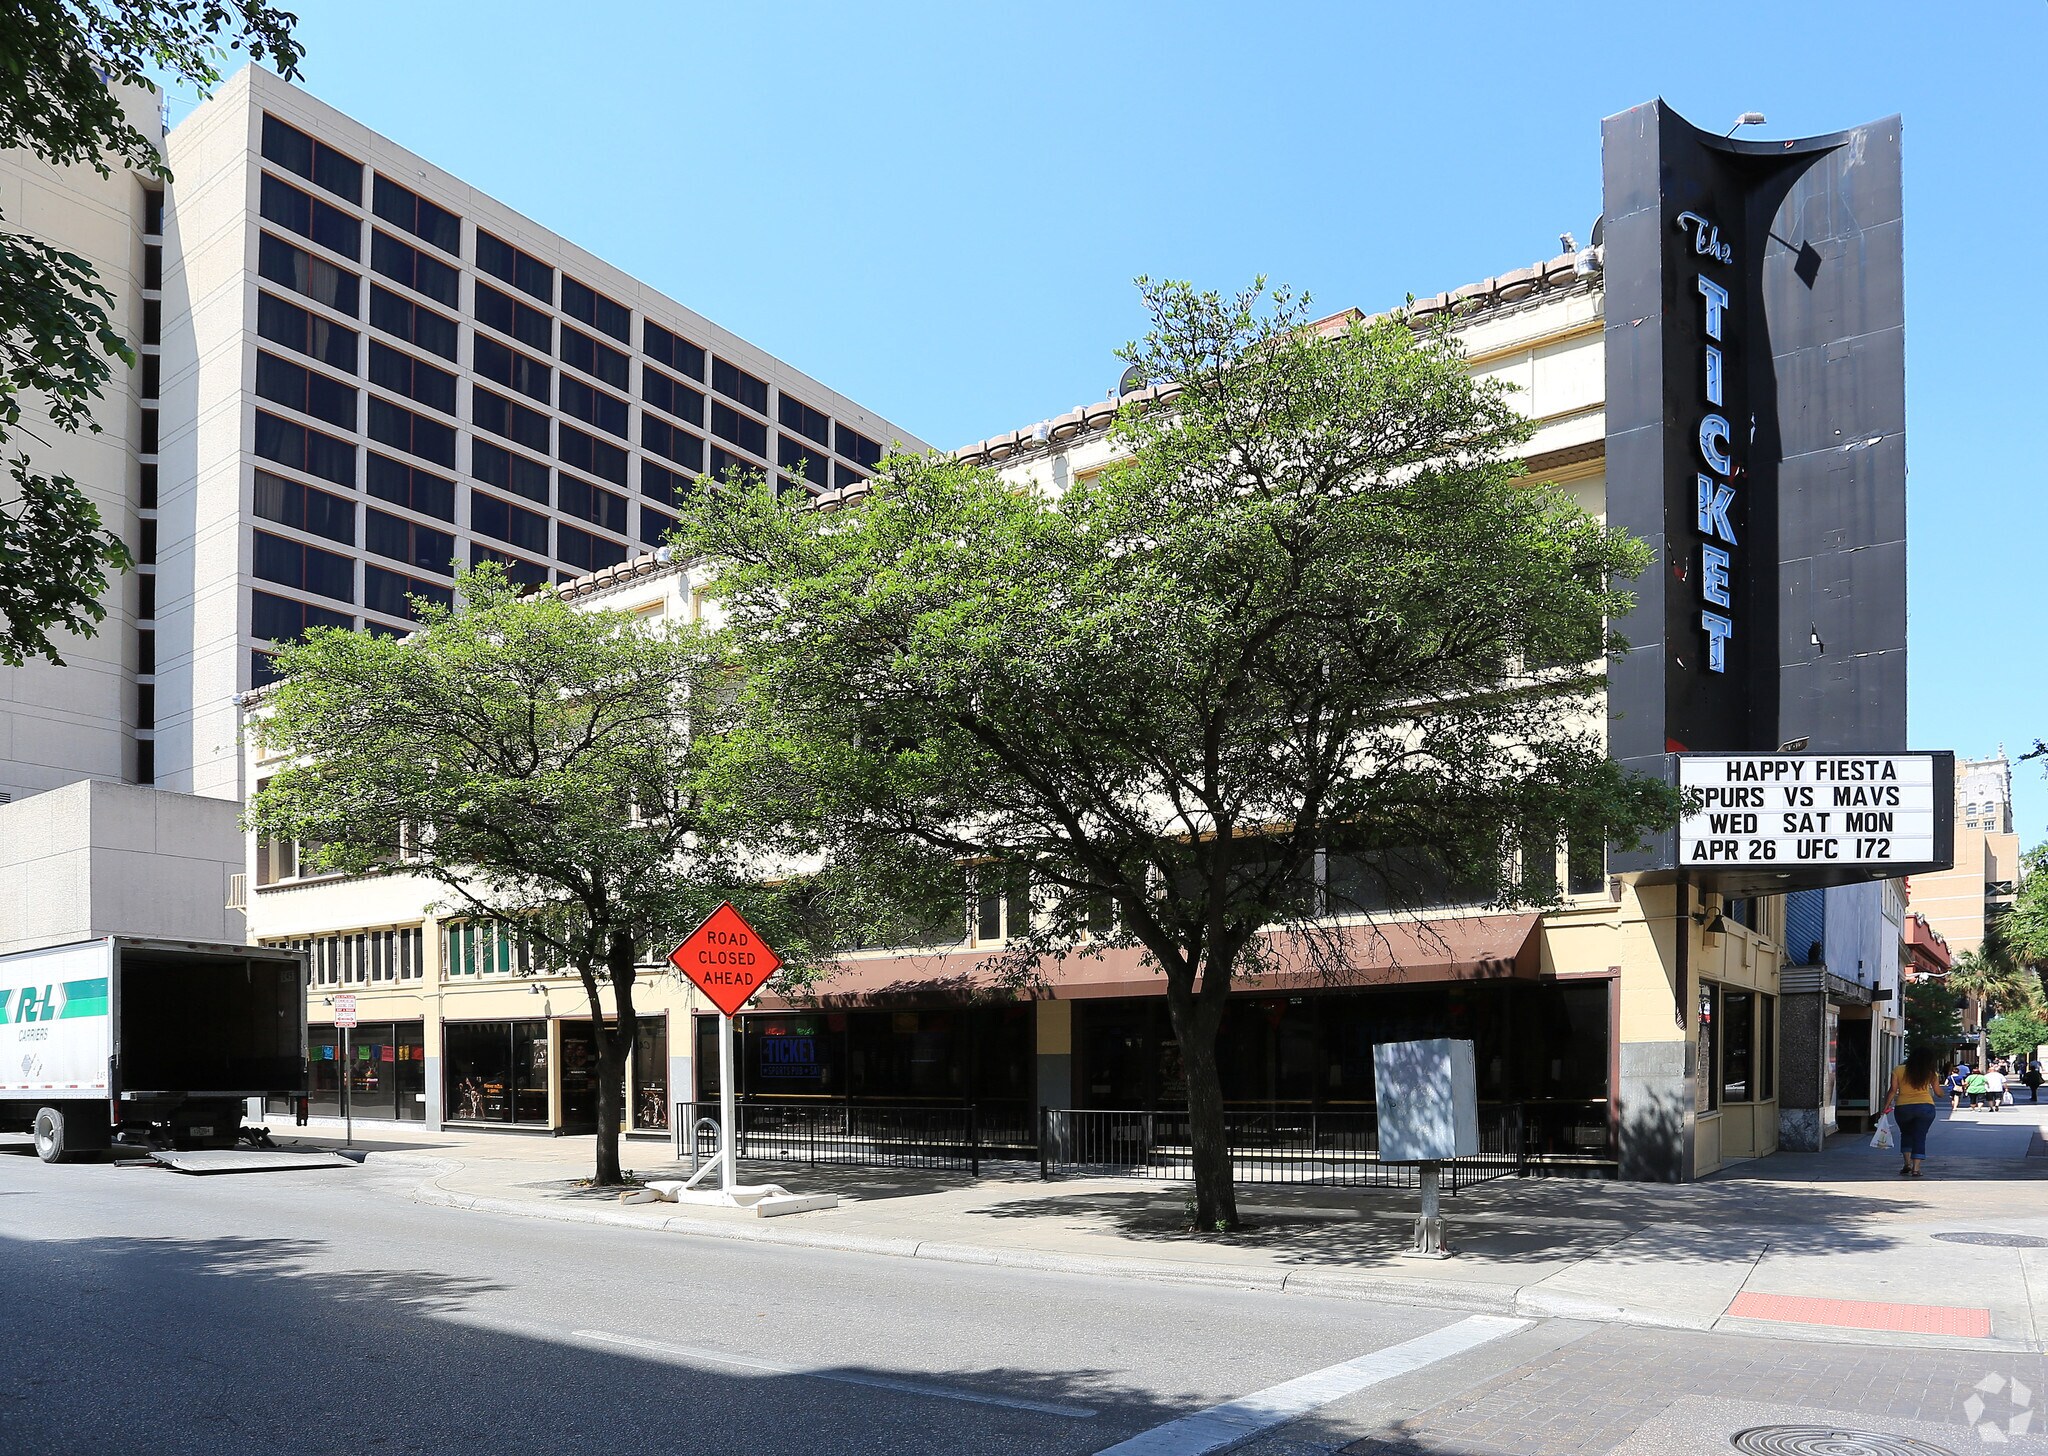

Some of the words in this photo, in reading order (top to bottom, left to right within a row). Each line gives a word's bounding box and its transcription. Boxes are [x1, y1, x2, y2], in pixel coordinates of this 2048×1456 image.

[1676, 210, 1733, 264] The
[1697, 273, 1738, 674] TICKET
[1727, 761, 1805, 781] HAPPY
[1817, 761, 1896, 780] FIESTA
[1691, 787, 1764, 807] SPURS
[1784, 787, 1813, 806] VS
[1834, 787, 1899, 806] MAVS
[1710, 814, 1757, 833] WED
[1784, 813, 1830, 832] SAT
[1846, 812, 1892, 832] MON
[1692, 840, 1738, 860] APR
[1750, 840, 1775, 859] 26
[1798, 839, 1837, 859] UFC
[1857, 838, 1890, 858] 172
[707, 931, 748, 946] ROAD
[698, 950, 756, 966] CLOSED
[703, 971, 754, 985] AHEAD
[767, 1039, 815, 1062] TICKET
